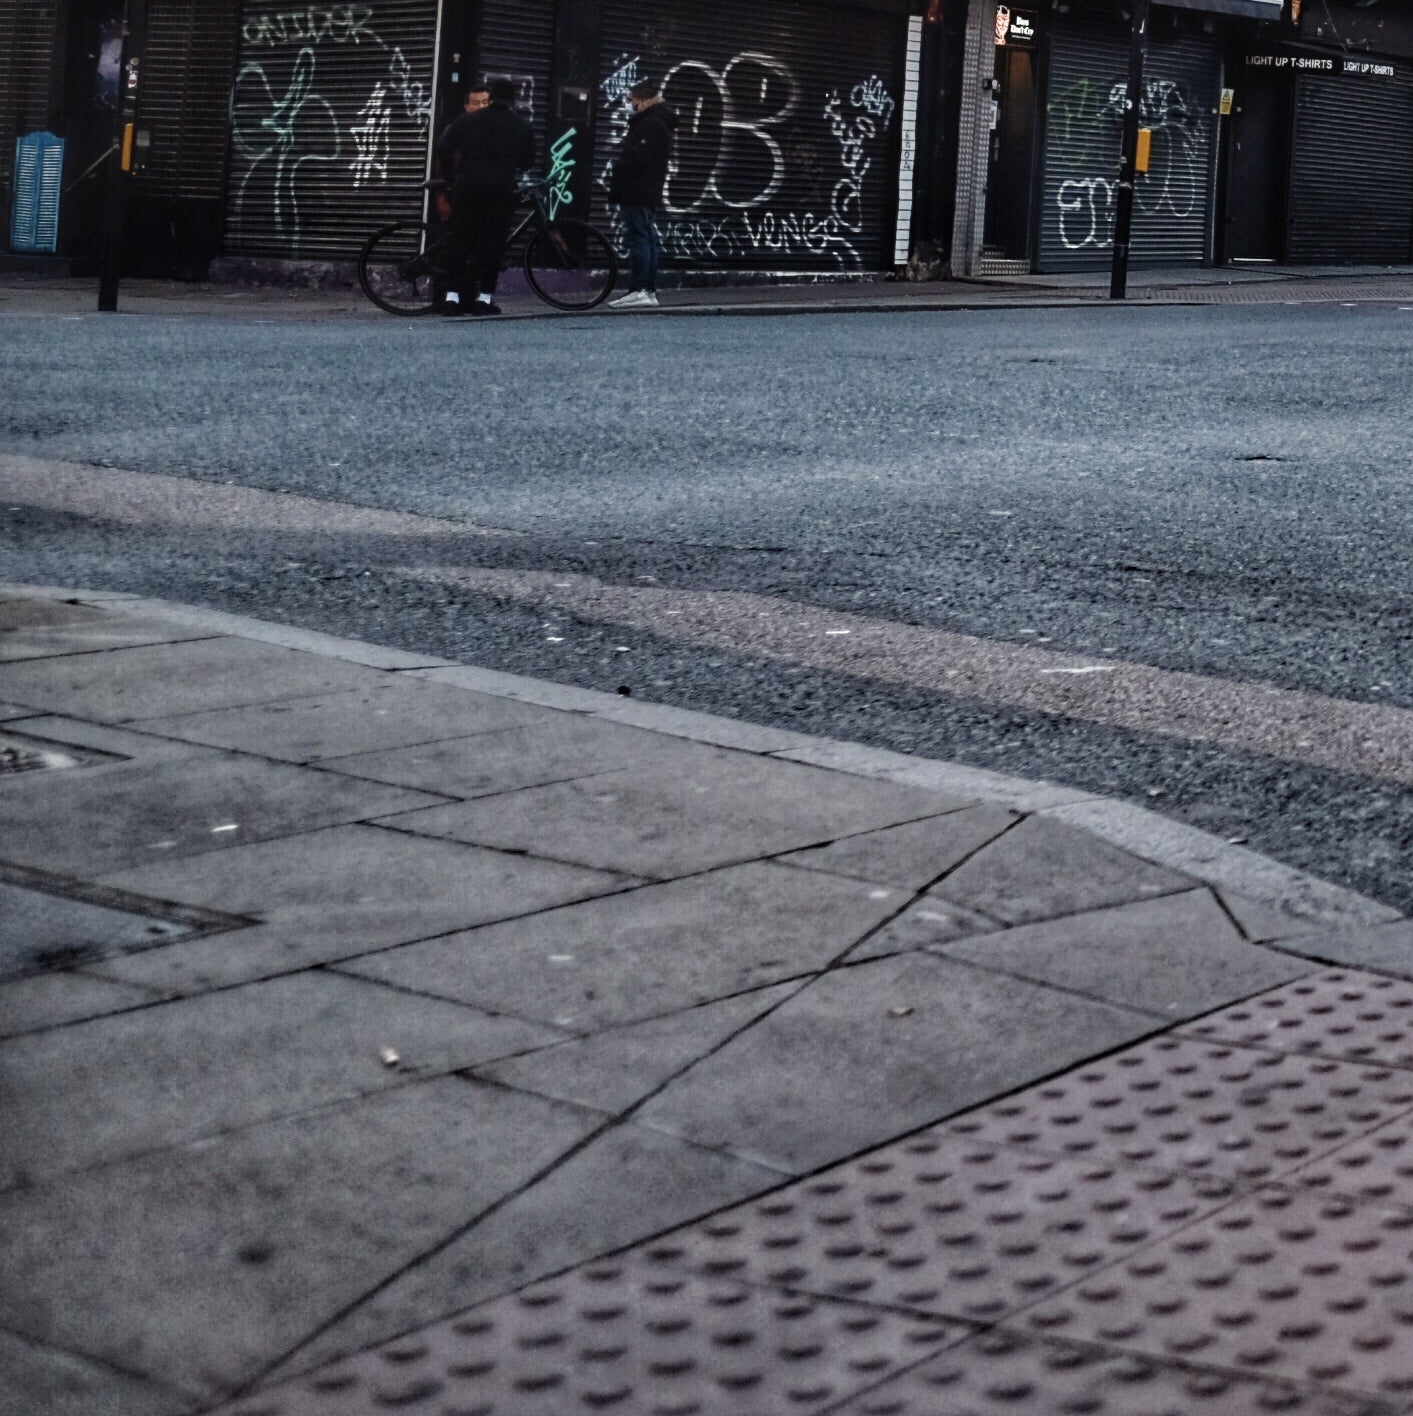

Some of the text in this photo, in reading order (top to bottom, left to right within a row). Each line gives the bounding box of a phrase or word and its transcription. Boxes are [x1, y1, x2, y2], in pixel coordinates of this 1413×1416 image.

[1245, 55, 1395, 76] LIGHT UP T-SHIRTS LIGHT UP T-SHIRTS
